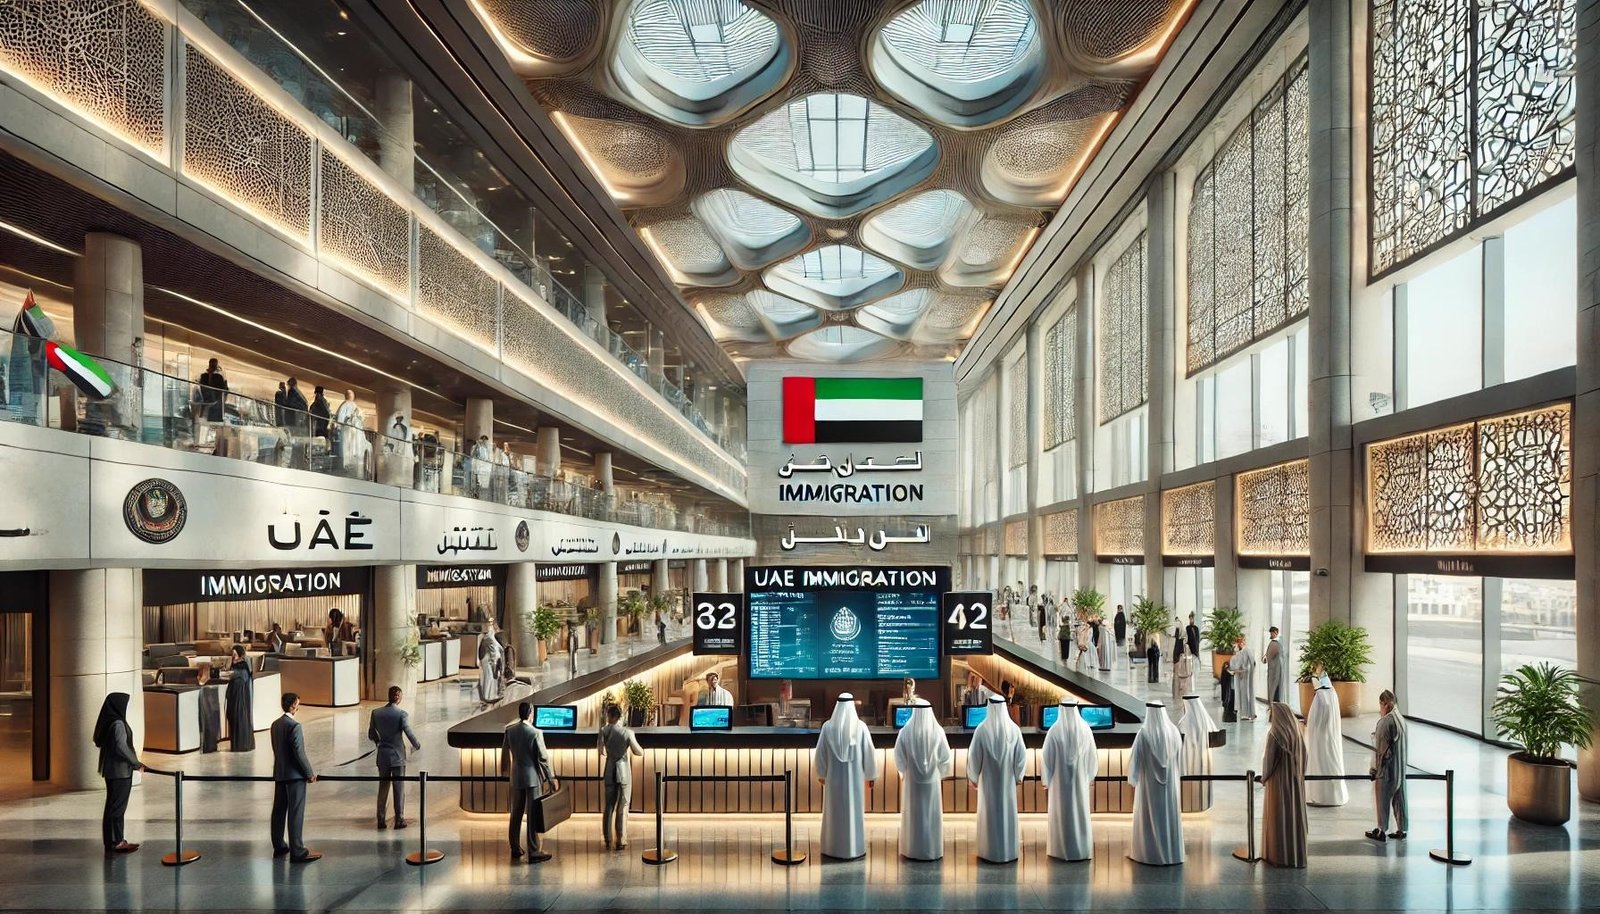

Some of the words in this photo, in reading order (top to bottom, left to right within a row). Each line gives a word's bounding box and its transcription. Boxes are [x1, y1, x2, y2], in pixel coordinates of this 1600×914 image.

[779, 485, 924, 503] IMMIGRATION
[201, 572, 341, 596] IMMIGRATION
[755, 569, 794, 587] UAE
[947, 602, 988, 630] 42
